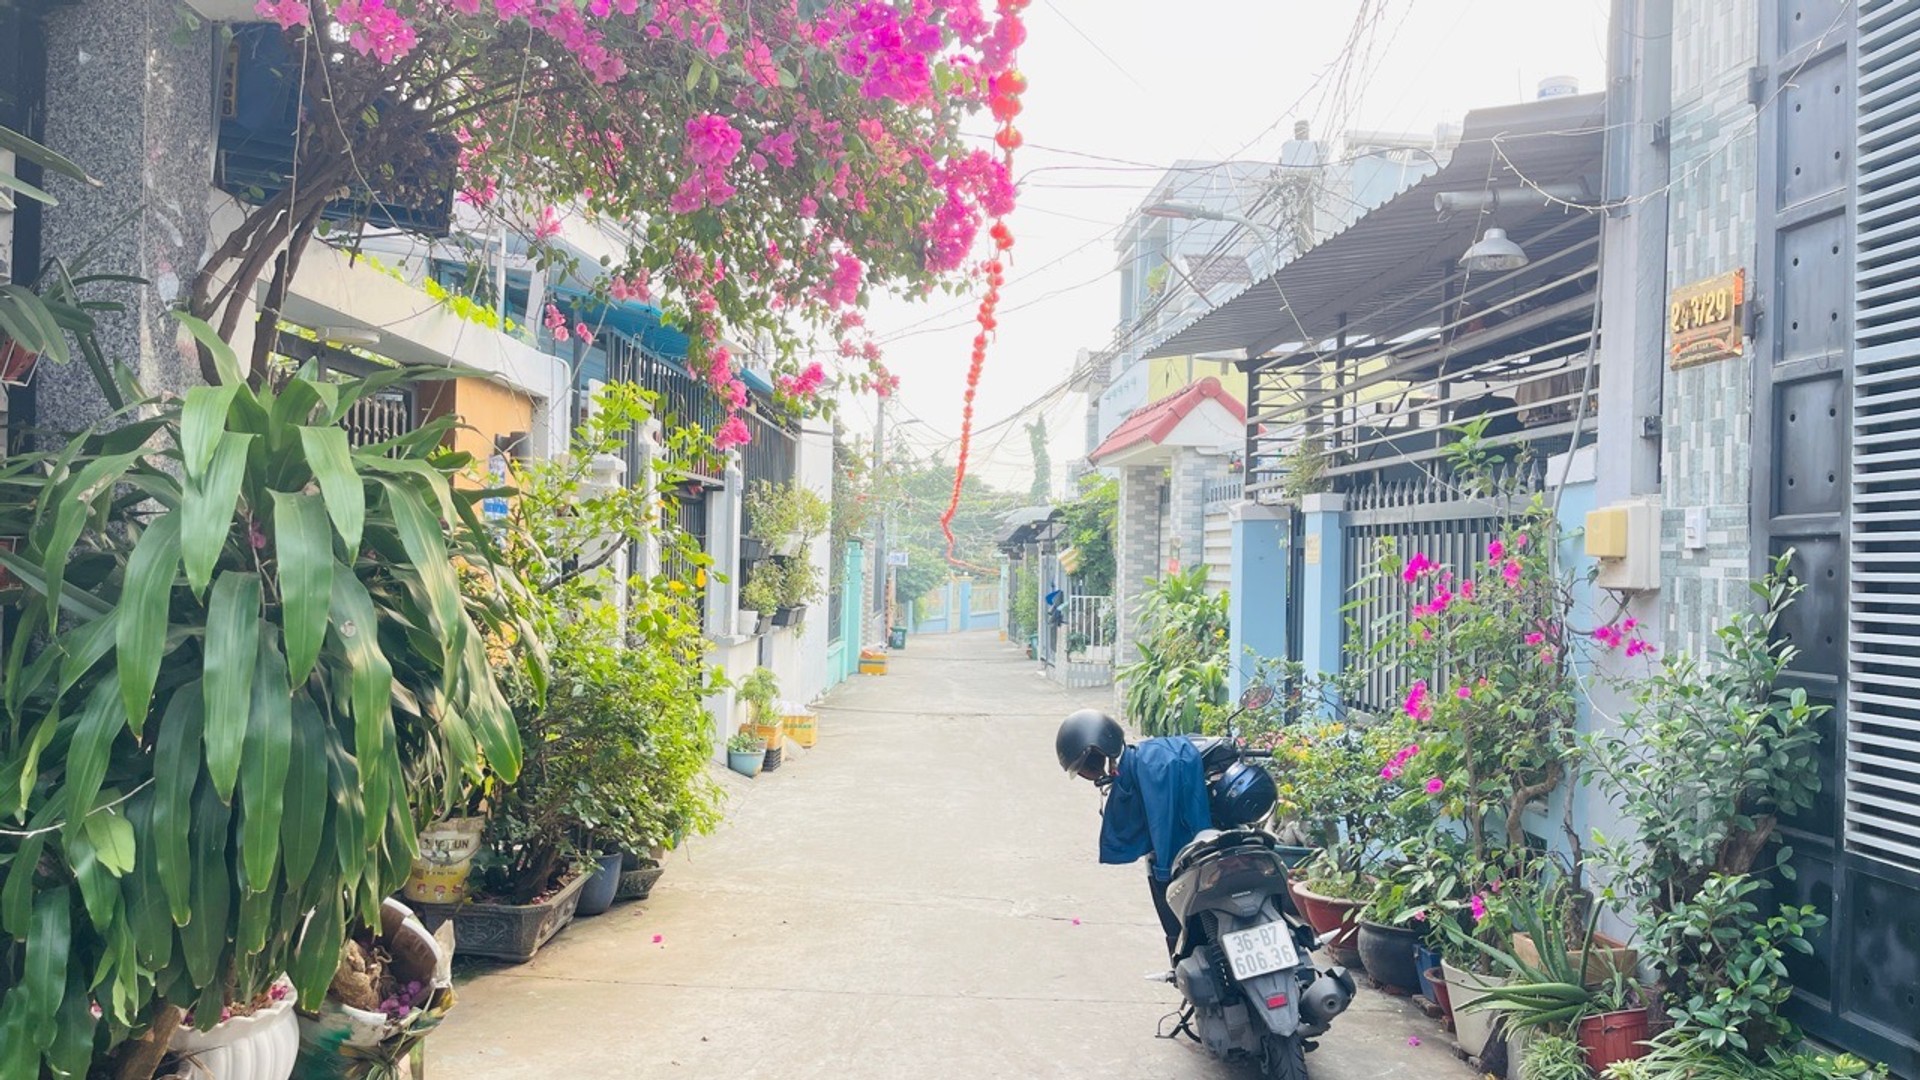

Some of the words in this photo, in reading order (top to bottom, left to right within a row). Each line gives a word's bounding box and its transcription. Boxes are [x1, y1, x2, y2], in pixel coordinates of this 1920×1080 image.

[1672, 288, 1727, 333] 243/29
[1233, 926, 1277, 953] 36-B7
[1234, 945, 1293, 976] 606.36
